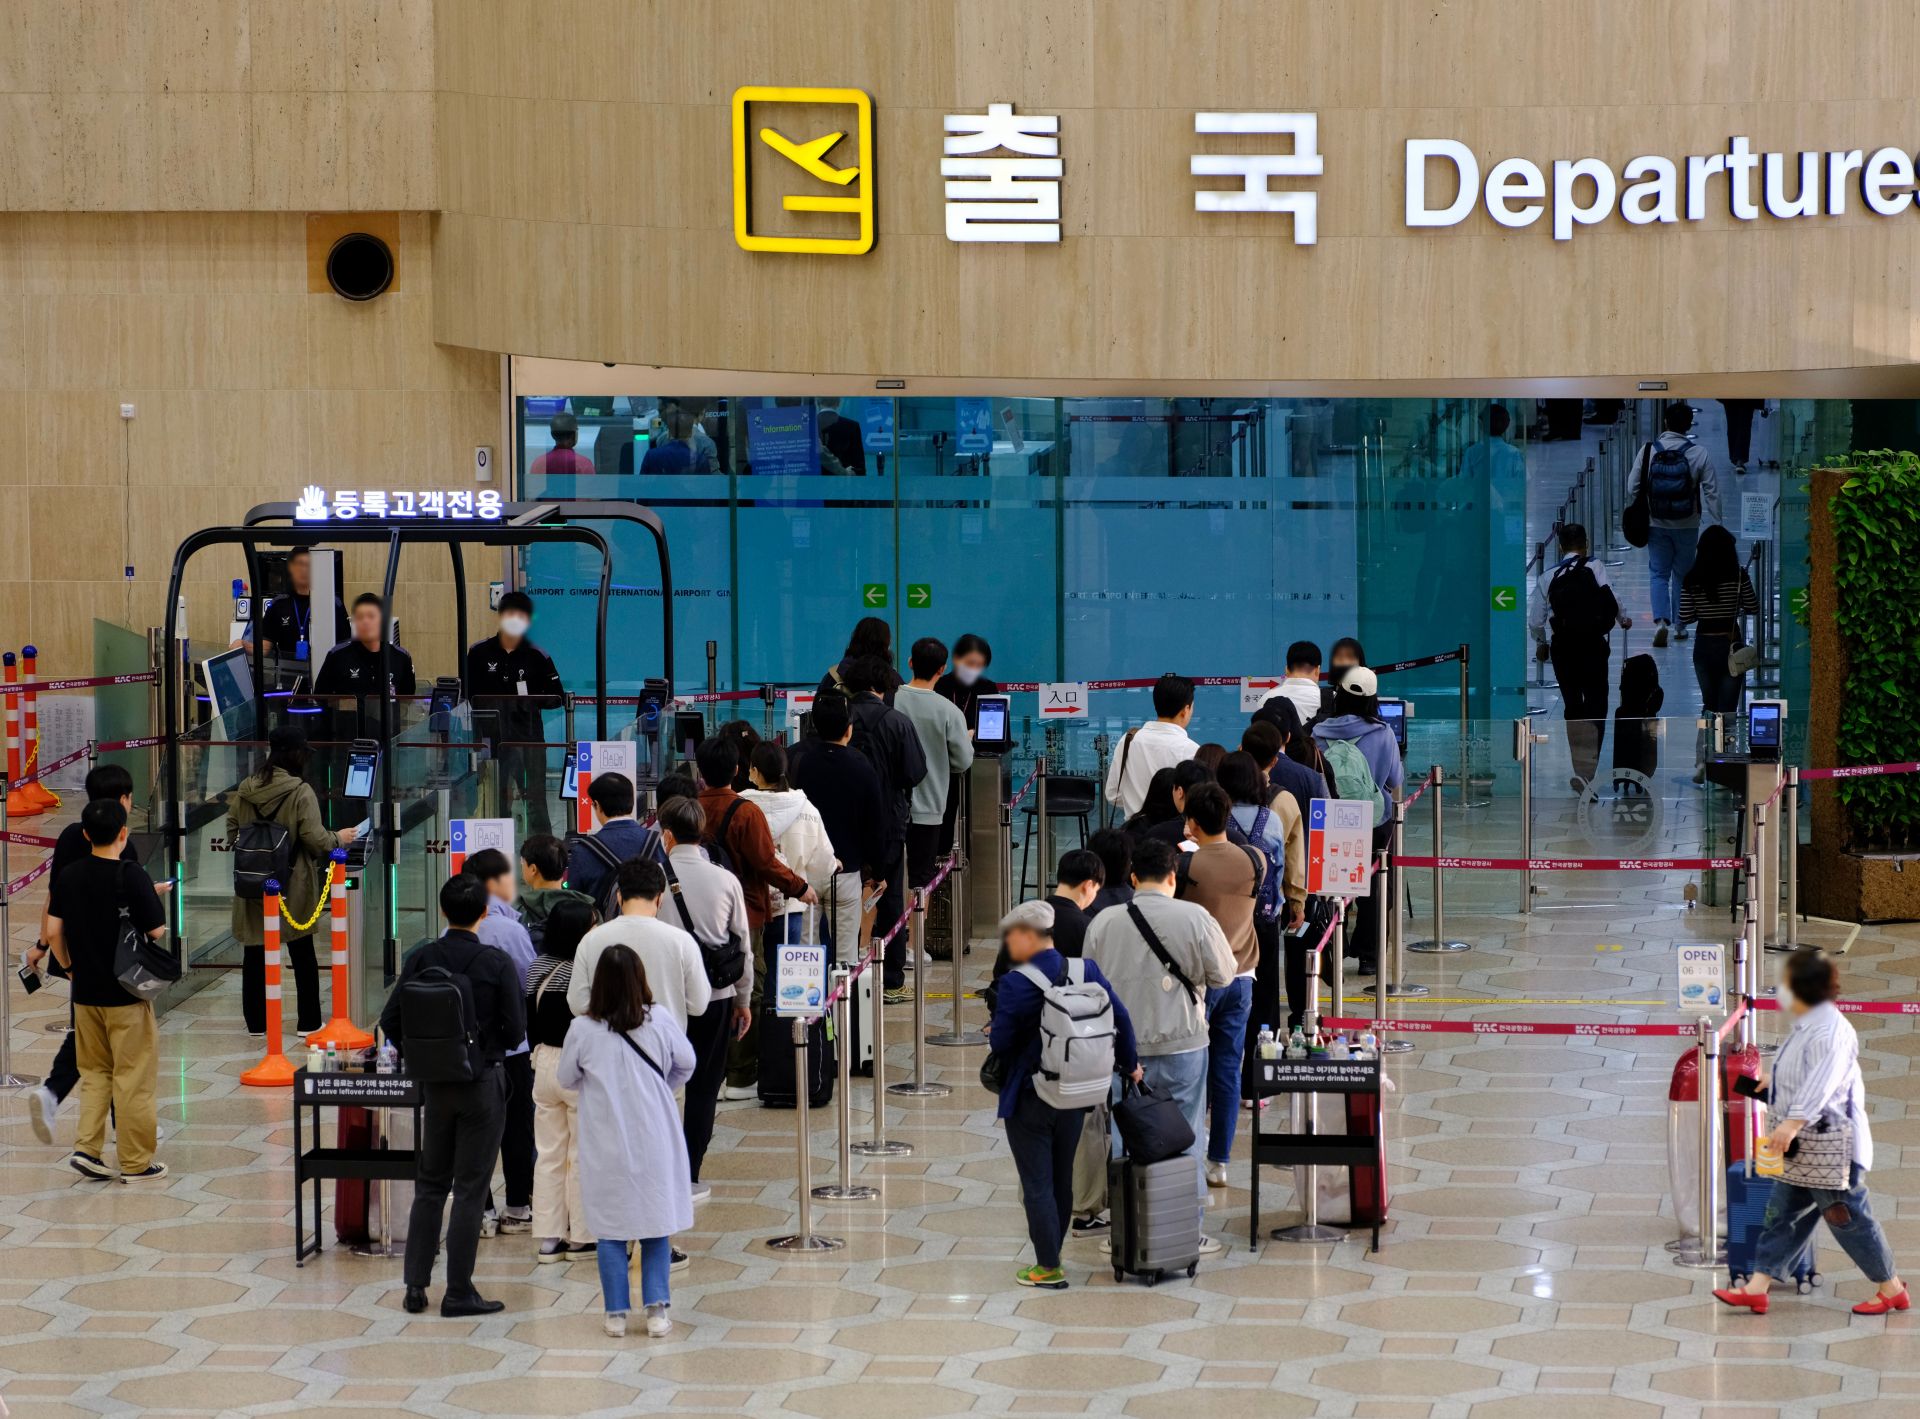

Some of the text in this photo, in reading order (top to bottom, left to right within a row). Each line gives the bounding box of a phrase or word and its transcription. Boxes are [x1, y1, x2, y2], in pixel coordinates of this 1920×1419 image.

[1405, 136, 1920, 240] Departure
[332, 489, 502, 519] 등록고객전용
[1049, 691, 1076, 704] 入口
[1832, 770, 1850, 778] KAC
[1613, 804, 1648, 822] AC
[1438, 859, 1460, 867] KAC
[1529, 860, 1550, 868] KAC
[1712, 860, 1733, 868] KAC
[785, 952, 818, 962] OPEN
[1684, 950, 1717, 960] OPEN
[1902, 1004, 1920, 1012] KA
[1372, 1020, 1396, 1030] KAC
[1473, 1023, 1498, 1032] KAC
[1574, 1026, 1600, 1034] KAC
[1678, 1026, 1695, 1035] KA
[1277, 1066, 1292, 1074] 남은
